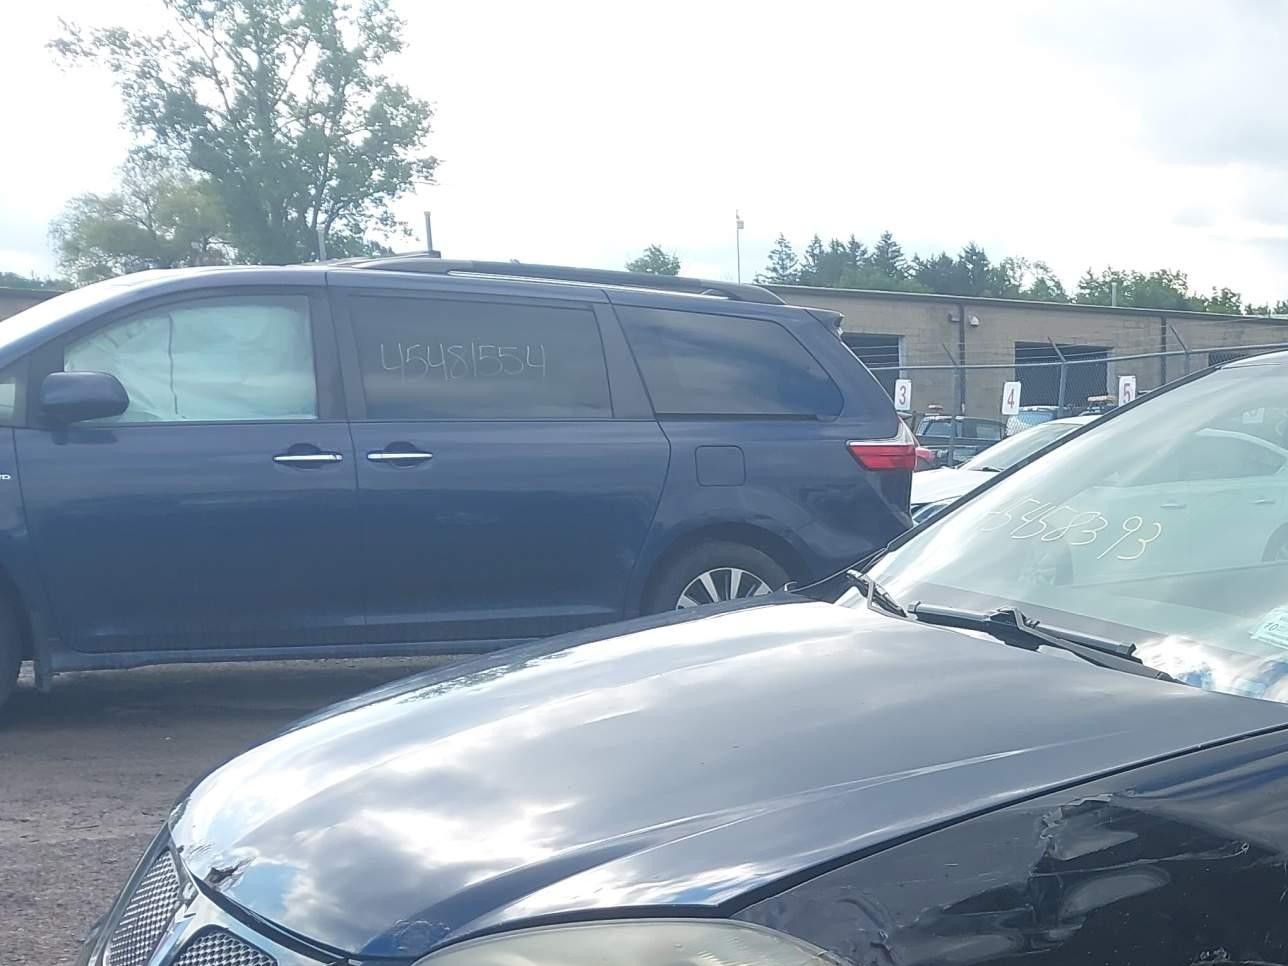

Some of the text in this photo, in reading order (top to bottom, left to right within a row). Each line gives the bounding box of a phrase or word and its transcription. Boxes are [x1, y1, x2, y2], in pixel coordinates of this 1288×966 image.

[379, 341, 547, 381] 45481554
[899, 385, 907, 405] 3
[1007, 388, 1015, 409] 4
[1123, 382, 1131, 403] 5
